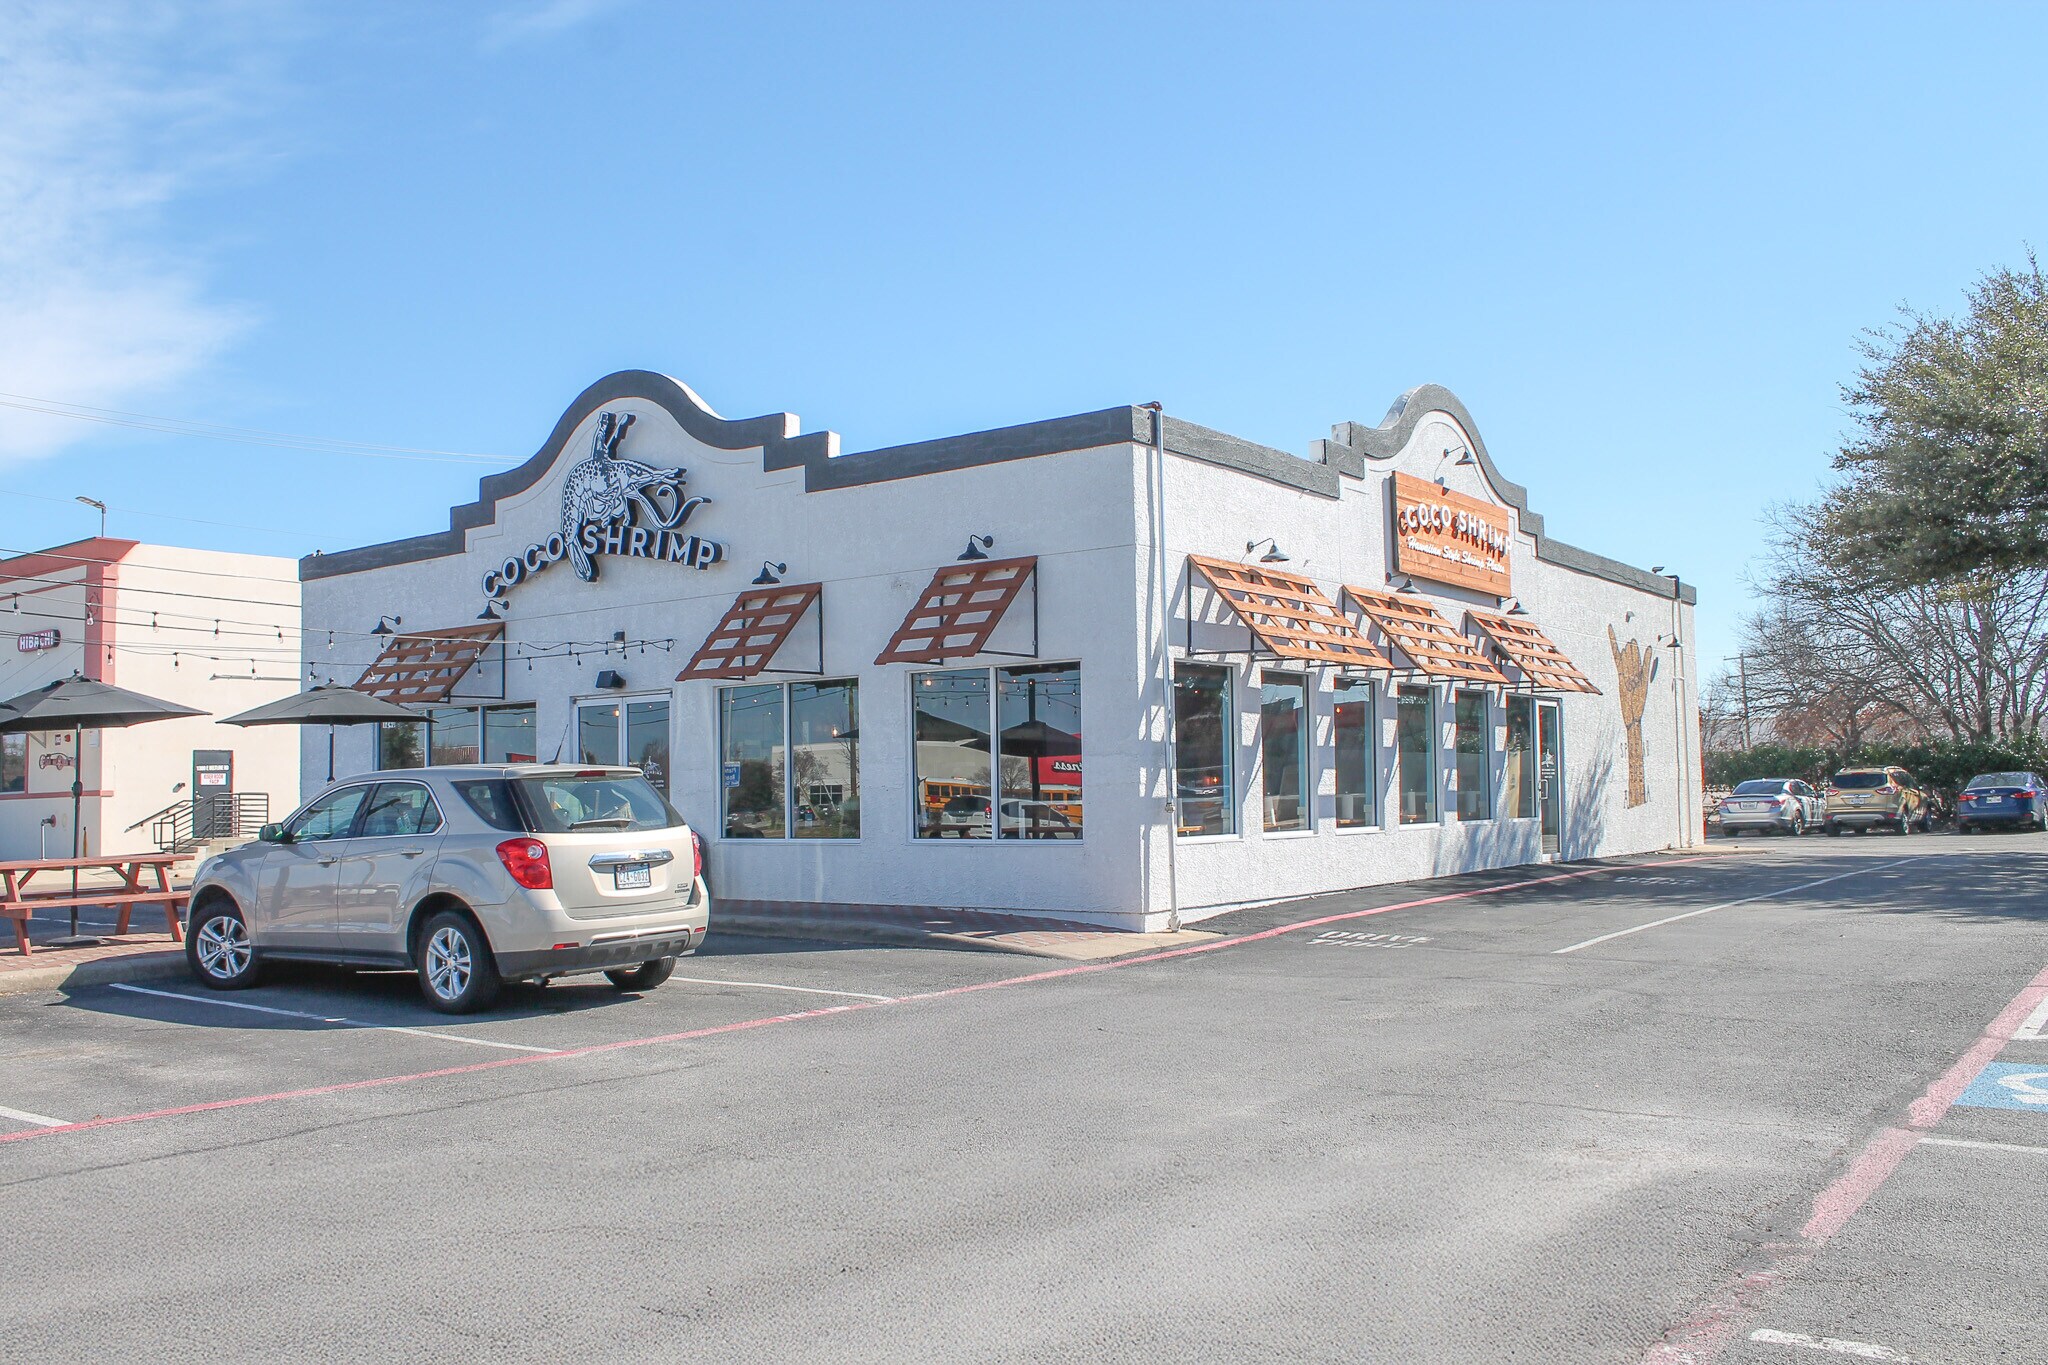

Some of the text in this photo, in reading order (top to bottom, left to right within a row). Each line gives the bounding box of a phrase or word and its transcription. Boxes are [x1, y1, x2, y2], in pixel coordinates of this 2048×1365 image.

[1405, 503, 1512, 555] COCO SHRIMP
[482, 525, 722, 598] COCO SHRIMP
[1461, 551, 1485, 571] Shrimp
[20, 631, 53, 650] HIBACHI
[1305, 938, 1414, 949] THRU
[1317, 930, 1435, 943] DRIVE
